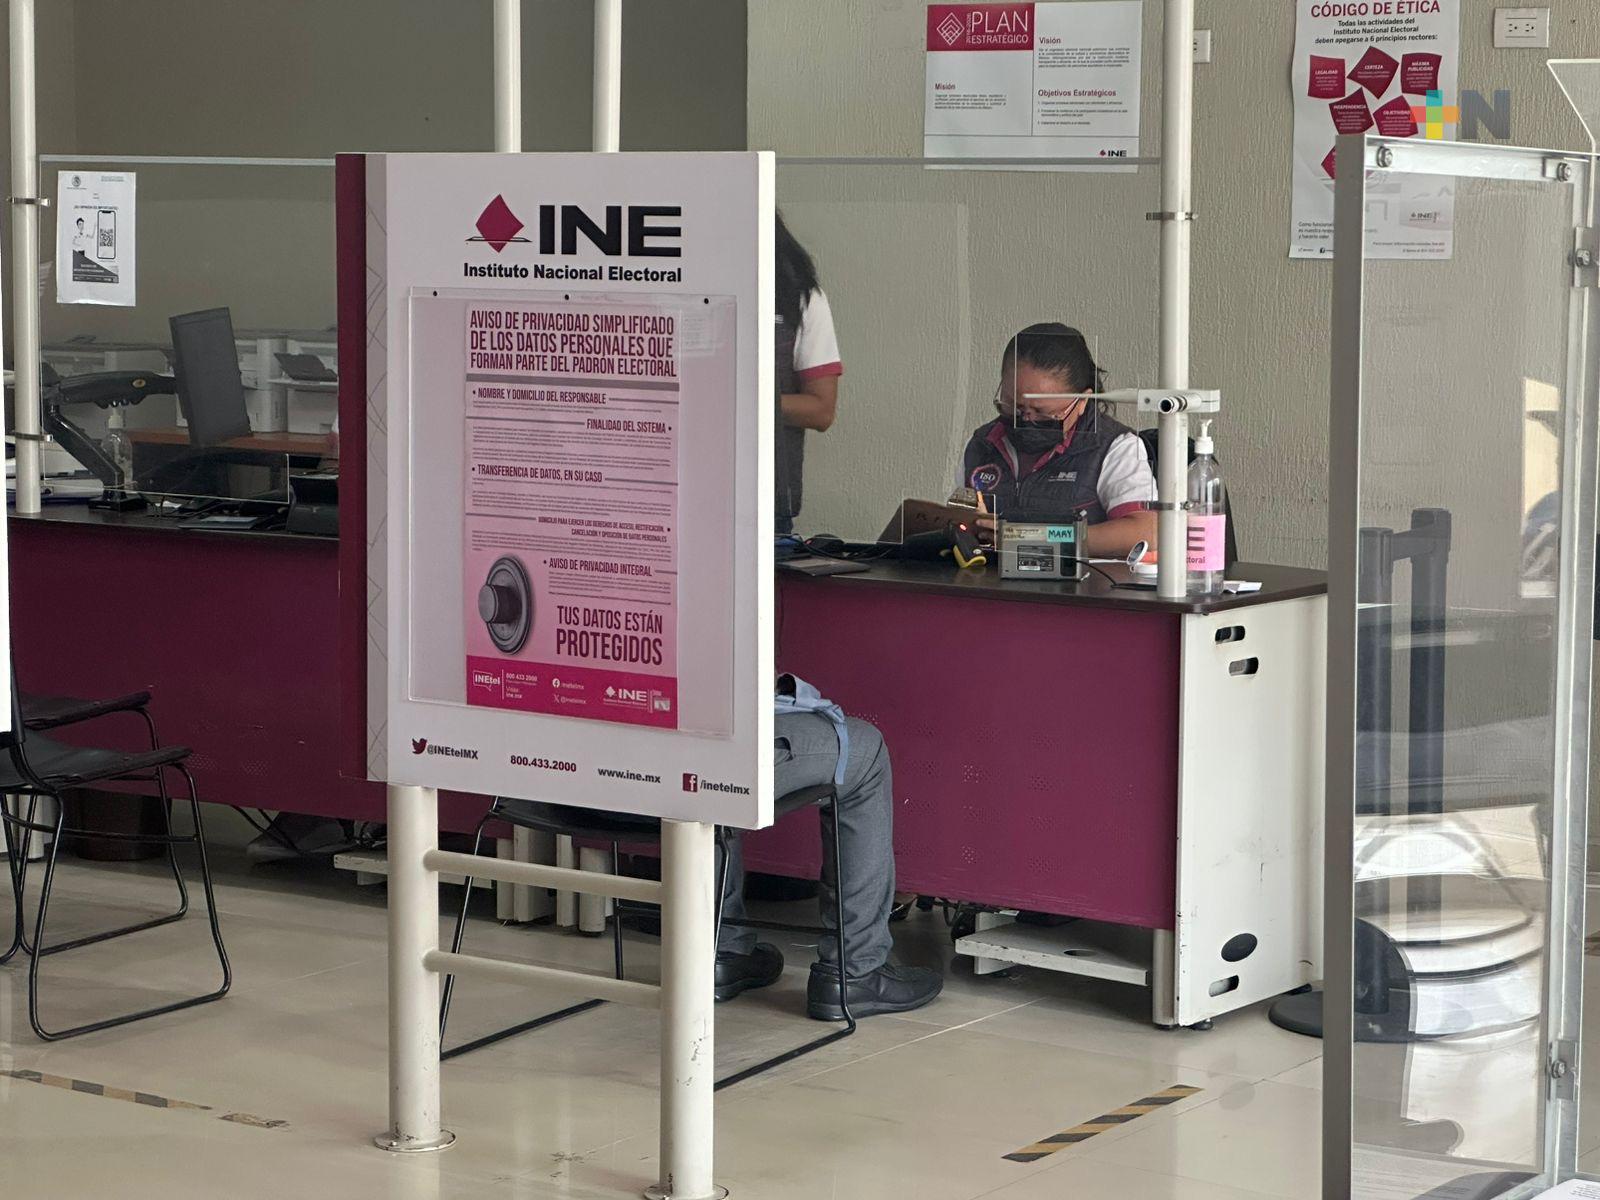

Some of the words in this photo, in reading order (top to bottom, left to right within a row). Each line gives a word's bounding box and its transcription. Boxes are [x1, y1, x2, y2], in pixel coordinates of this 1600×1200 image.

[1311, 1, 1369, 18] CÓDIGO
[1373, 2, 1392, 15] DE
[1397, 0, 1440, 14] ÉTICA
[972, 10, 1029, 33] PLAN
[1367, 18, 1403, 26] actividades
[1390, 25, 1418, 33] Electoral
[971, 33, 1029, 45] ESTRATÉGICO
[1039, 36, 1061, 44] Visión
[1335, 36, 1363, 44] apegarse
[1375, 34, 1407, 43] principios
[1408, 33, 1439, 41] rectores:
[935, 82, 956, 90] Misión
[1038, 89, 1072, 98] Objetivos
[1073, 88, 1117, 98] Estratégicos
[539, 205, 682, 257] INE
[464, 262, 529, 278] Instituto
[534, 264, 603, 280] Nacional
[608, 266, 682, 282] Electoral
[470, 310, 502, 330] AVISO
[505, 311, 519, 330] DE
[522, 312, 590, 332] PRIVACIDAD
[593, 315, 674, 336] SIMPLIFICADO
[471, 331, 487, 350] DE
[490, 332, 514, 352] LOS
[517, 333, 557, 354] DATOS
[560, 334, 645, 357] PERSONALES
[648, 337, 674, 358] QUE
[471, 352, 513, 370] FORMAN
[515, 354, 548, 372] PARTE
[551, 356, 570, 373] DEL
[572, 352, 615, 375] PADRÓN
[618, 358, 678, 378] ELECTORAL
[478, 387, 505, 400] NOMBRE
[506, 389, 512, 400] Y
[512, 389, 545, 402] DOMICILIO
[546, 390, 559, 402] DEL
[560, 391, 607, 405] RESPONSABLE
[587, 418, 622, 431] FINALIDAD
[623, 420, 636, 432] DEL
[637, 421, 666, 434] SISTEMA
[478, 463, 529, 478] TRANSFERENCIA
[529, 467, 539, 478] DE
[540, 468, 563, 481] DATOS,
[564, 469, 573, 480] EN
[574, 470, 583, 481] SU
[584, 470, 603, 482] CASO
[1048, 529, 1073, 539] MARY
[1187, 526, 1205, 551] E
[549, 557, 568, 570] AVISO
[569, 559, 578, 570] DE
[580, 560, 619, 574] PRIVACIDAD
[620, 563, 653, 577] INTEGRAL
[557, 605, 580, 626] TUS
[583, 607, 621, 630] DATOS
[625, 610, 663, 634] ESTÁN
[556, 628, 663, 666] PROTEGIDOS
[475, 673, 500, 685] INEtel
[619, 688, 647, 701] INE
[427, 744, 479, 760] @INEtelMX
[510, 754, 577, 773] 800.433.2000
[597, 767, 661, 783] www.ine.mx
[700, 779, 751, 795] /inetelmx
